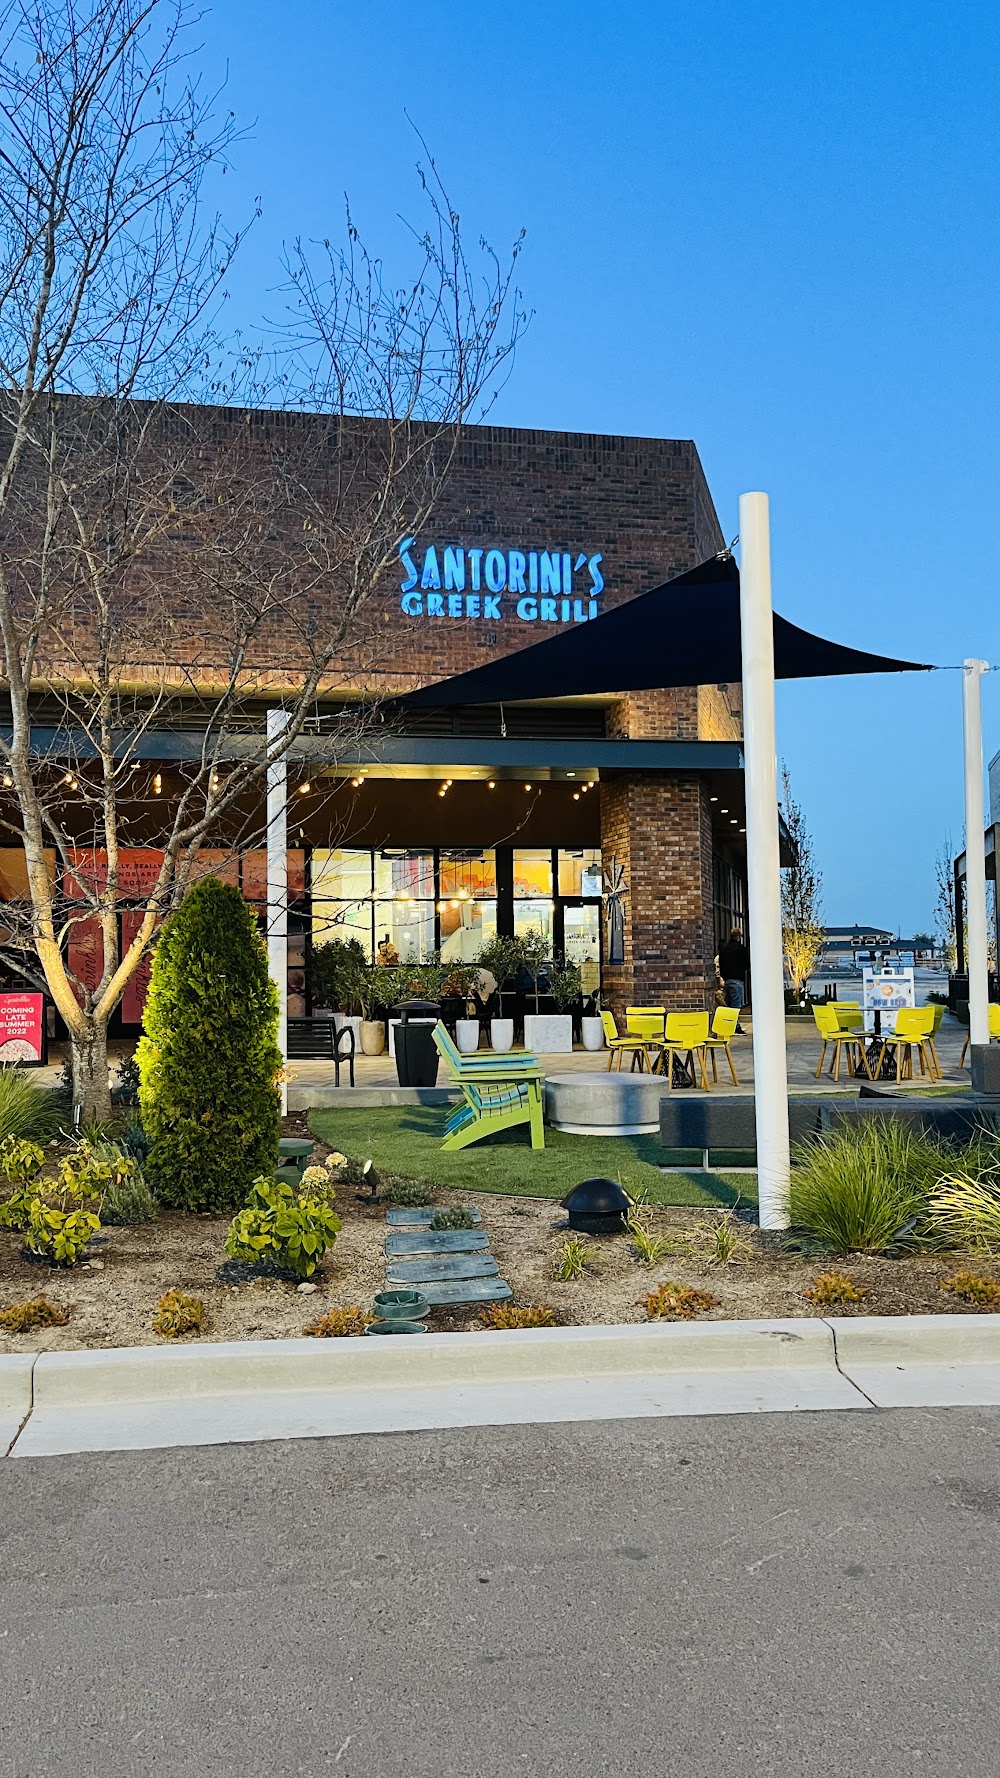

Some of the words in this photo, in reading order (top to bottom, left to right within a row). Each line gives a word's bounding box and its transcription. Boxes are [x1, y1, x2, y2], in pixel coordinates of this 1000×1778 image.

[399, 536, 604, 597] SANTORINI'S
[401, 591, 502, 620] GREEK
[0, 1020, 36, 1028] SUMMER
